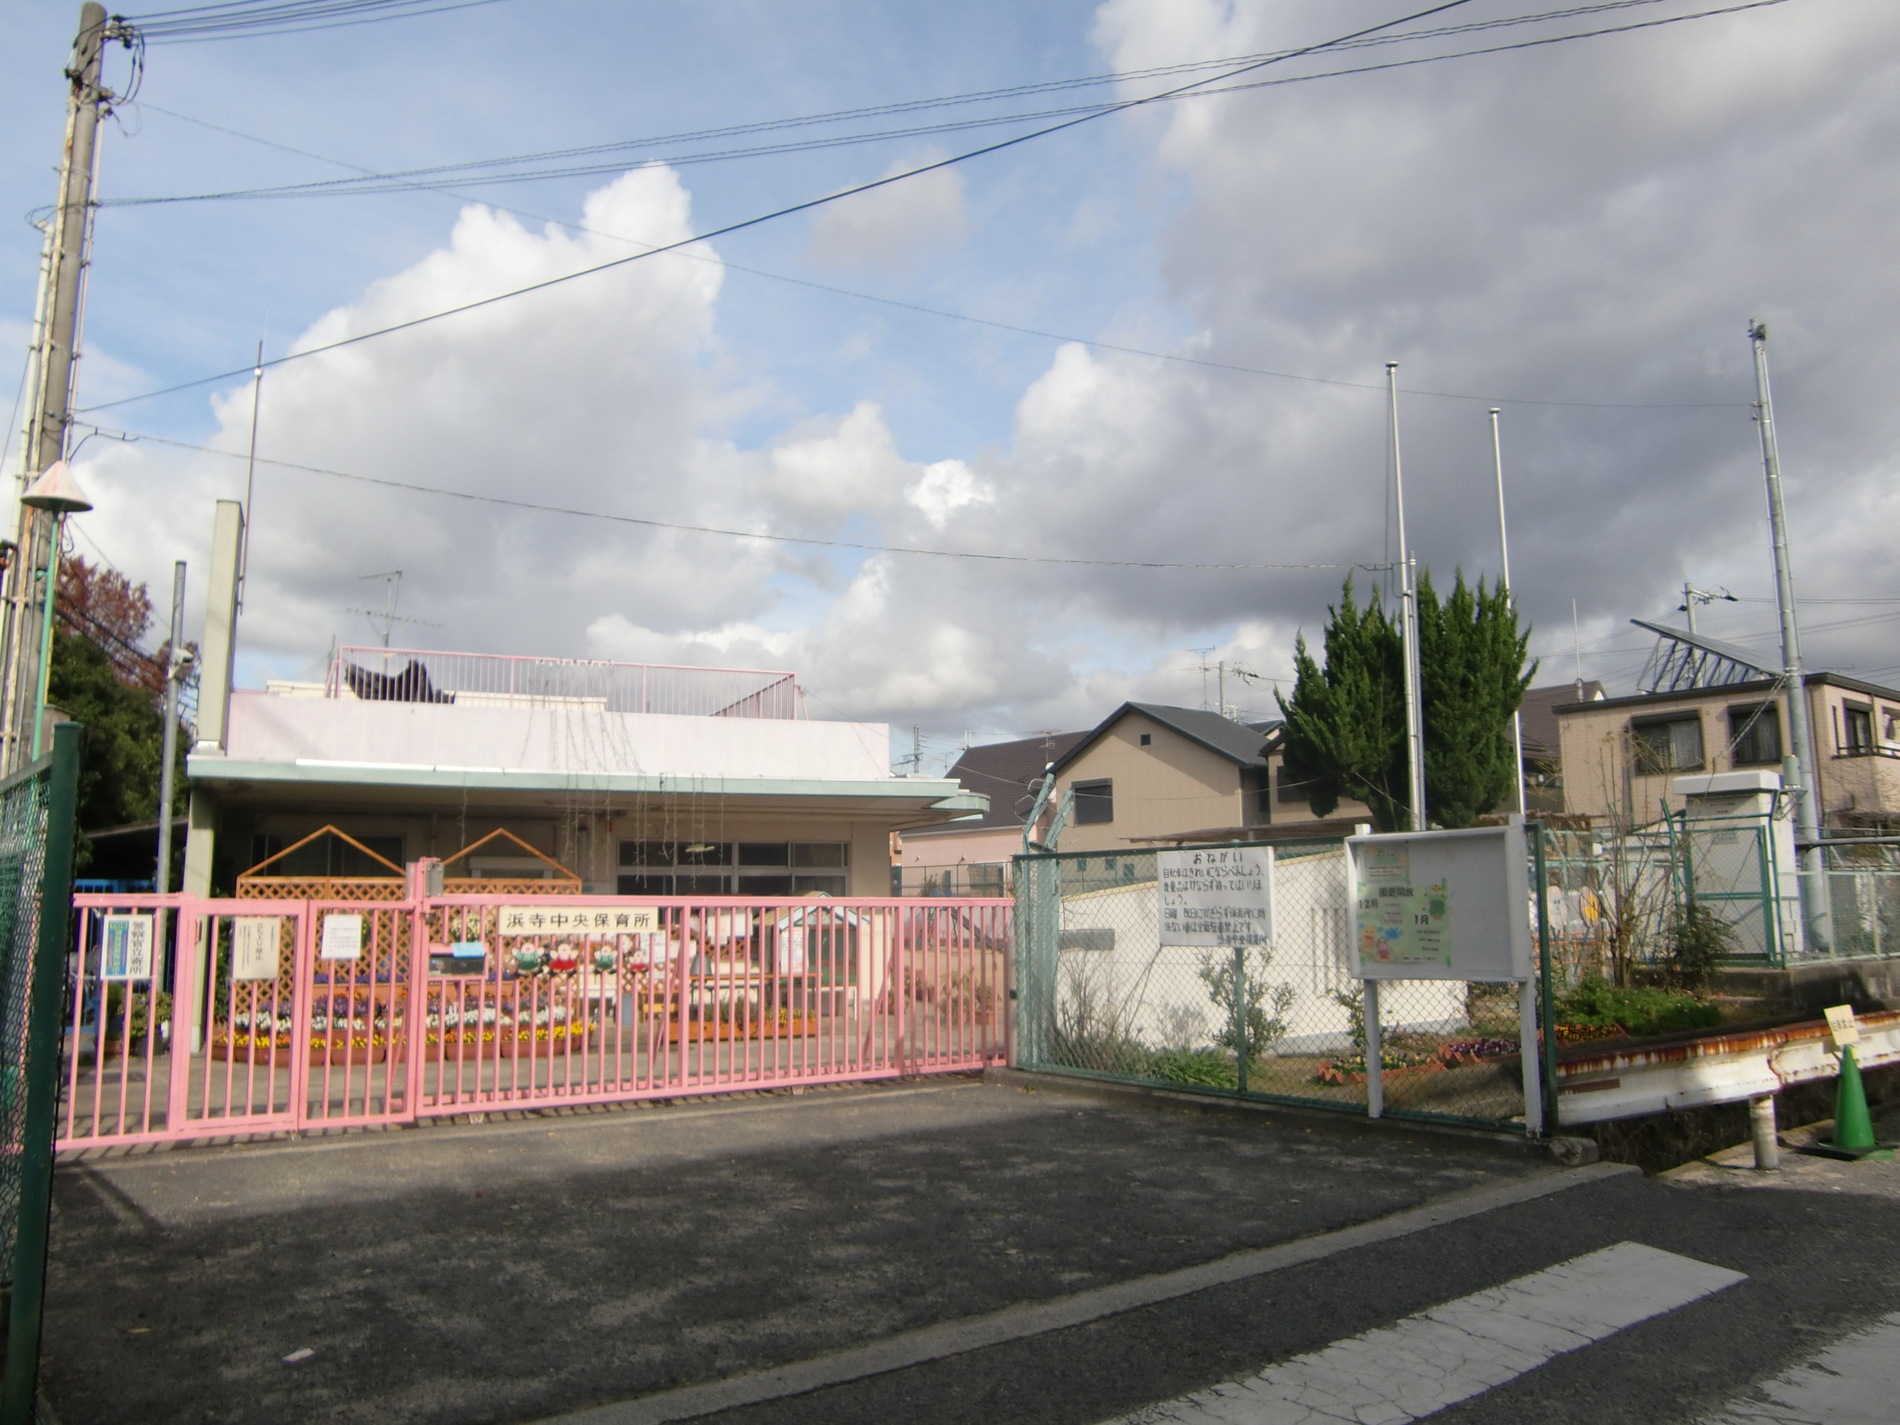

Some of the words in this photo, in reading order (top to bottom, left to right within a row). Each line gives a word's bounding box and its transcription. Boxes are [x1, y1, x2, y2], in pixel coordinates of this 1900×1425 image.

[1193, 852, 1243, 865] おねがい
[1359, 898, 1379, 909] 12月
[506, 912, 651, 929] 浜寺中央保育所
[1414, 914, 1430, 925] 1月
